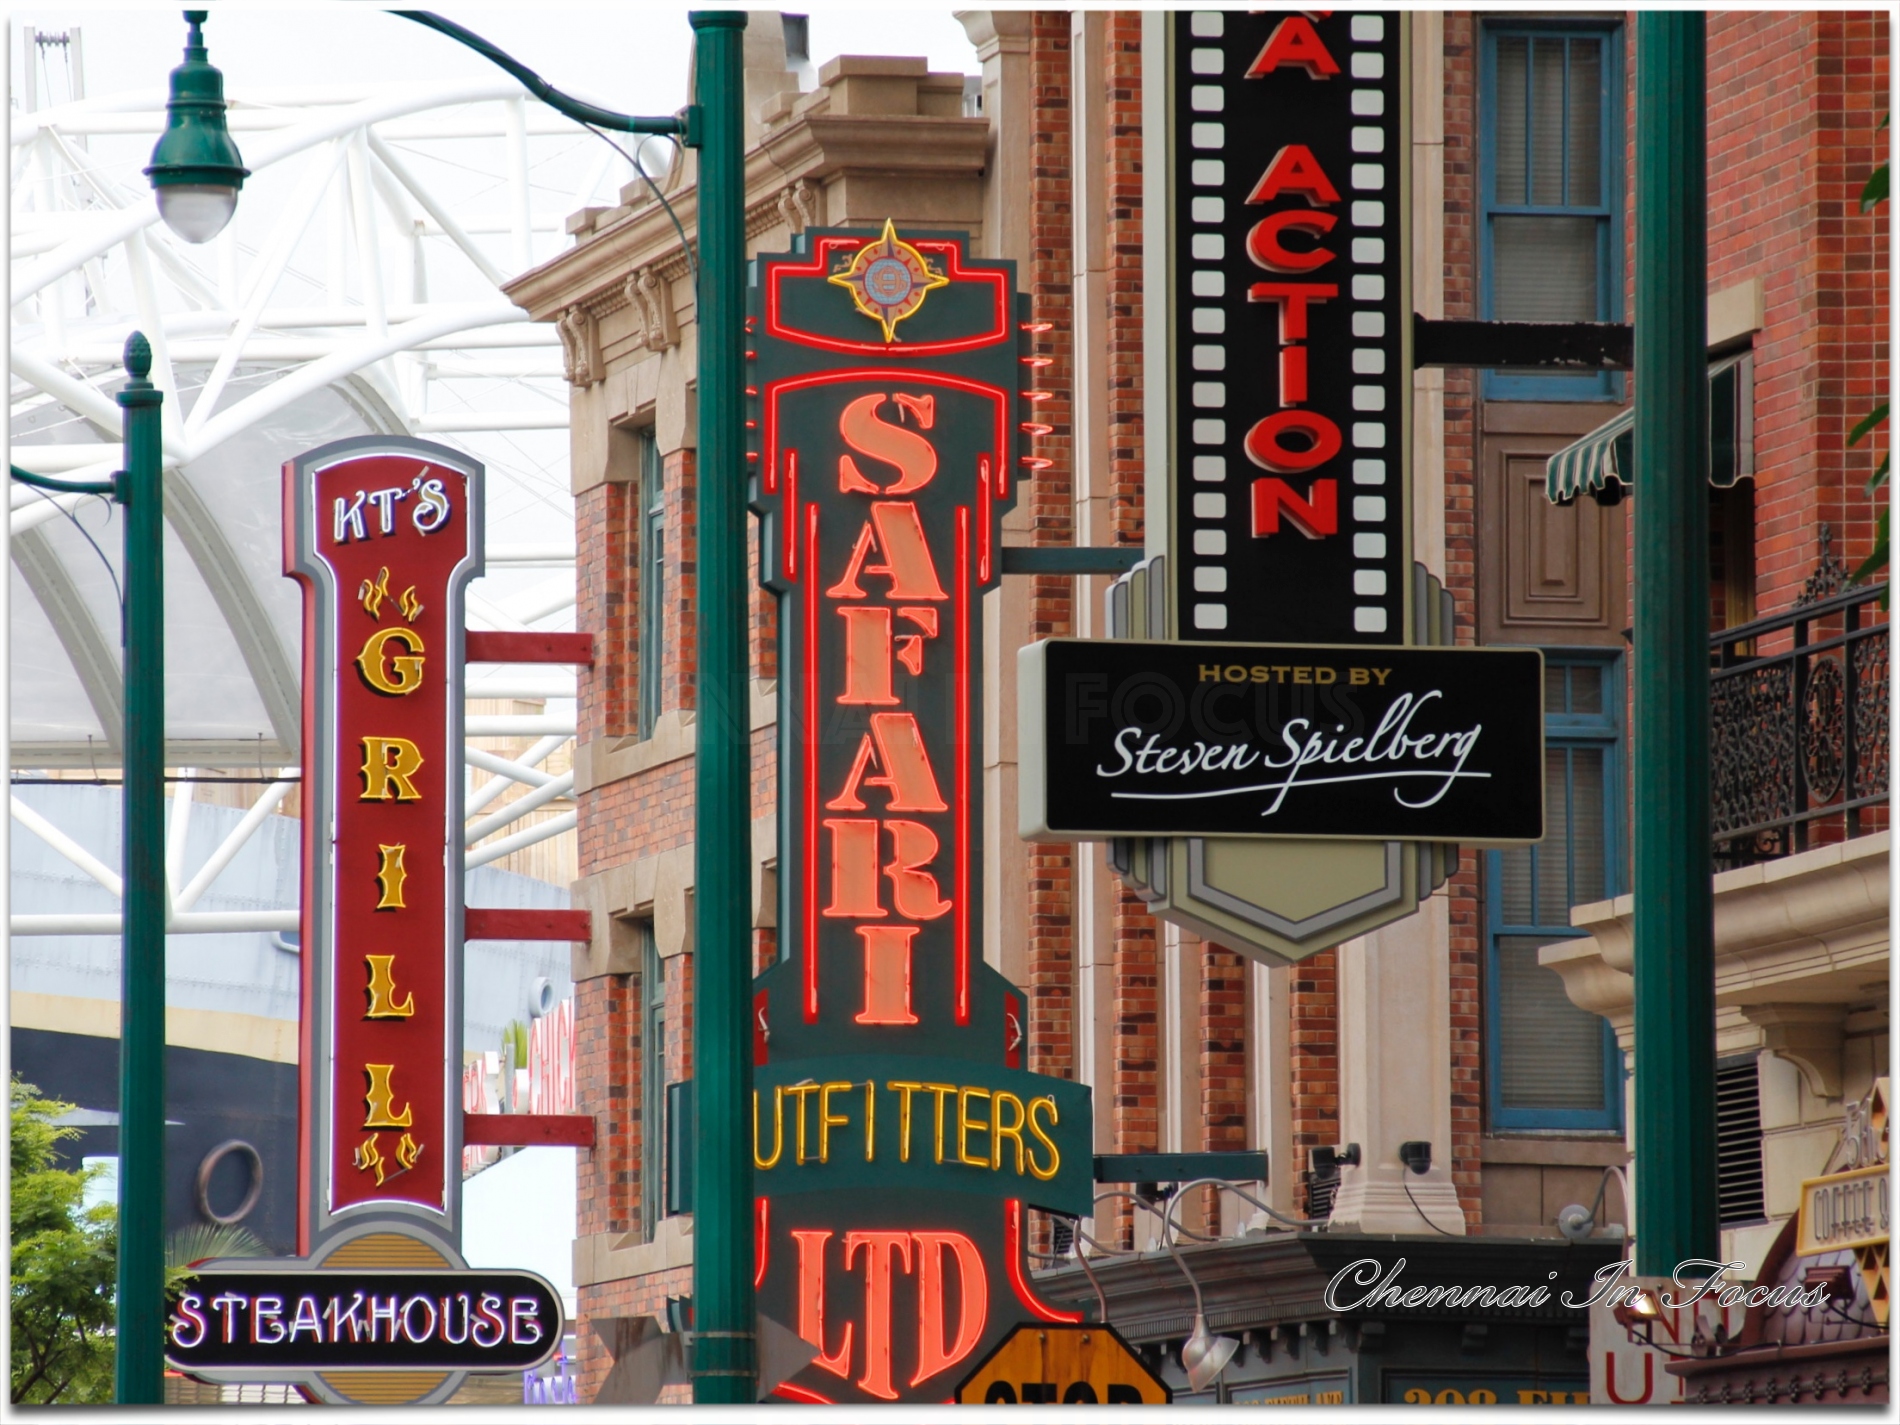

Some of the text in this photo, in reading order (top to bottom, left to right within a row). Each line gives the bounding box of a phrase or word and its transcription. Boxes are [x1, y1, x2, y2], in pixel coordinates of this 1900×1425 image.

[1243, 143, 1344, 540] ACTION
[331, 474, 452, 546] KT'S
[822, 392, 953, 1028] SAFARI
[1197, 663, 1393, 688] HOSTED BY
[1095, 689, 1484, 817] Steven Spielberg
[356, 627, 427, 1130] GRILL
[753, 1079, 1062, 1182] UTFITTERS
[168, 1289, 542, 1351] STEAKHOUSE
[789, 1230, 989, 1400] LTD
